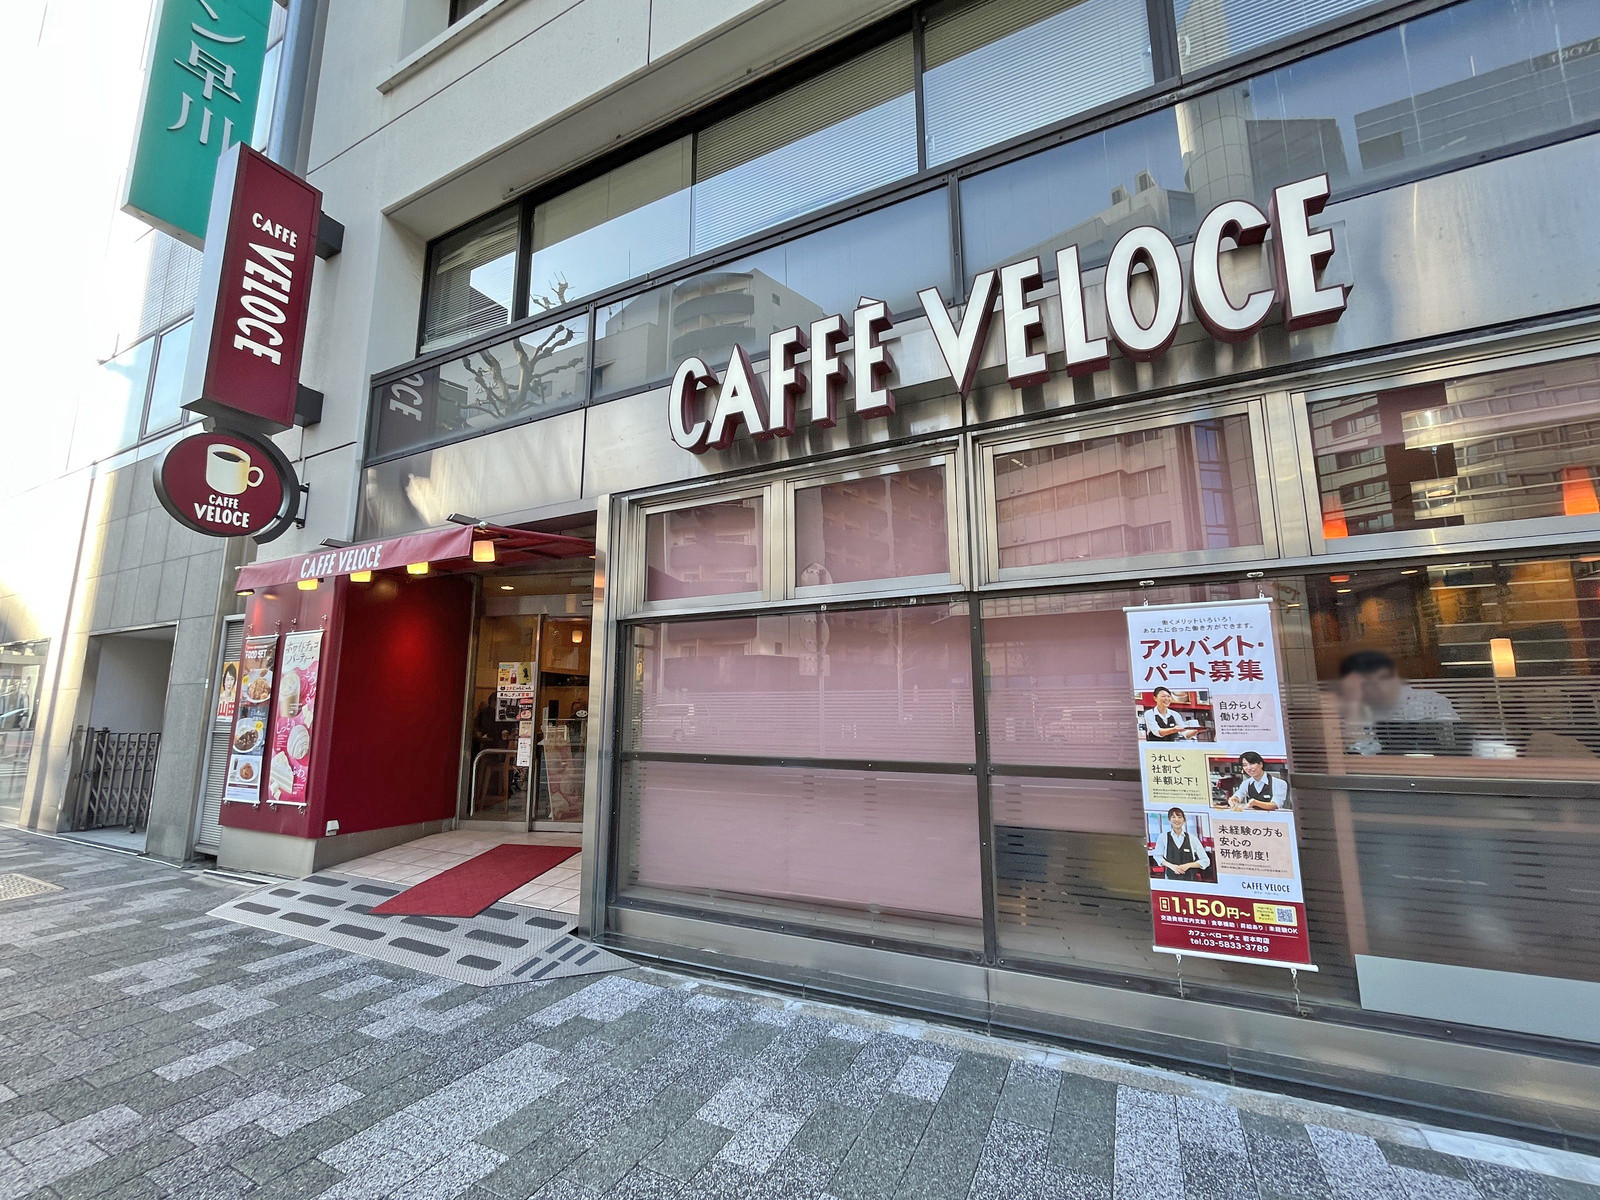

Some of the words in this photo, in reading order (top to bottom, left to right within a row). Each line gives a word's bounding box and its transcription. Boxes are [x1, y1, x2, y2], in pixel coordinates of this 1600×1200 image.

[916, 173, 1347, 398] VELOCE
[233, 242, 296, 366] VELOCE
[193, 502, 250, 528] VELOCE
[338, 544, 383, 573] VELOCE
[257, 649, 267, 659] SET
[1144, 659, 1265, 683] パート募集
[1219, 700, 1263, 711] 自分らしく
[1151, 753, 1185, 763] うれしい
[1151, 764, 1181, 774] 社割で
[1218, 824, 1284, 838] 未経験の方も
[1219, 836, 1252, 848] 安心の
[1264, 883, 1290, 893] VELOCE
[1190, 938, 1270, 953] tel.03-5833-3789
